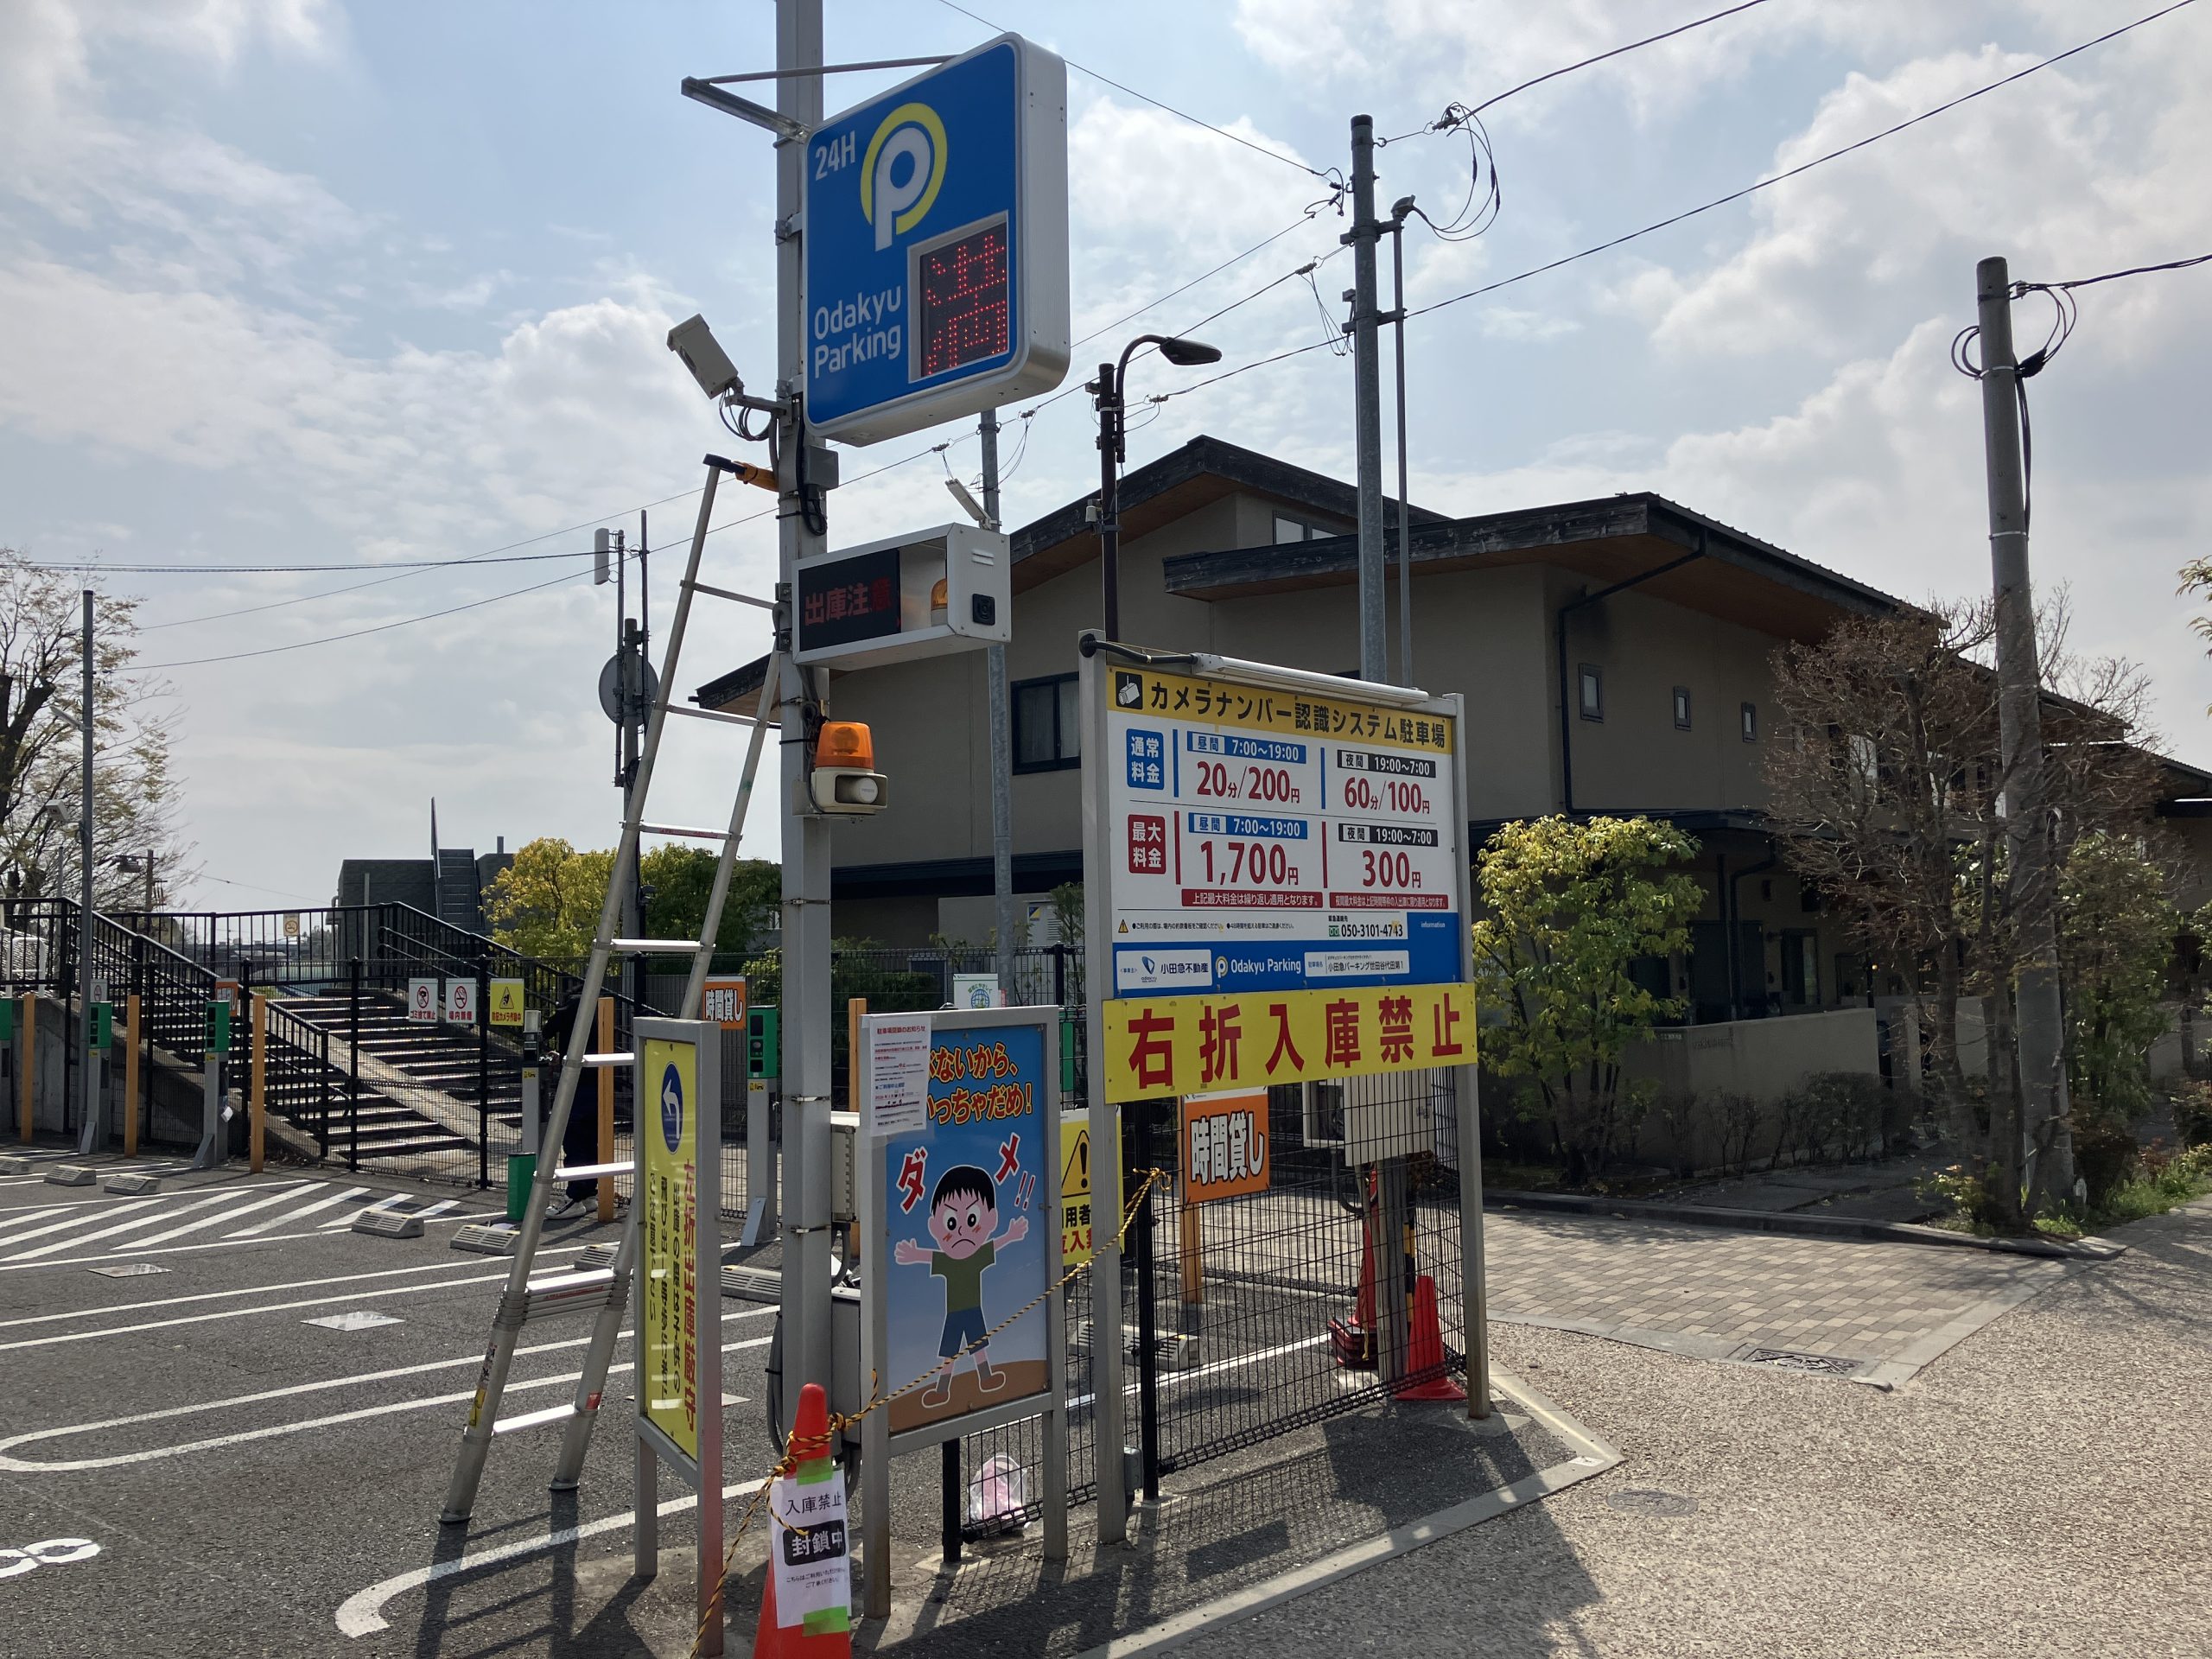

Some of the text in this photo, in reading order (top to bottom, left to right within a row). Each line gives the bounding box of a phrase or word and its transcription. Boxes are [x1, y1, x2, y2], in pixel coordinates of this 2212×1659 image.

[815, 130, 855, 181] 24H
[815, 286, 901, 340] Odakyu
[815, 325, 901, 378] Parking
[804, 576, 891, 626] 出庫注
[1151, 681, 1445, 748] カメラナンバー認識システム駐車場
[1131, 735, 1160, 759] 通常
[1198, 734, 1220, 753] 昼間
[1131, 761, 1160, 784] 料金
[1345, 753, 1364, 769] 夜間
[1197, 760, 1300, 804] 20分/200円
[1344, 777, 1430, 815] 60分/100円
[1133, 822, 1161, 843] 最大
[1198, 817, 1221, 836] 昼間
[1347, 827, 1365, 842] 夜間
[1133, 847, 1162, 868] 料金
[1200, 841, 1299, 886] 1,700円
[1363, 850, 1421, 889] 300円
[1341, 924, 1403, 938] 050-3101-4743
[1160, 963, 1209, 975] 小田急不動産
[1231, 958, 1301, 975] Odakyu Parking
[705, 989, 743, 1021] 時間貸し
[1128, 992, 1463, 1089] 右折入庫禁止
[1190, 1109, 1264, 1185] 時間貸し
[1062, 1204, 1091, 1230] 用者
[785, 1491, 842, 1516] 入庫禁止
[792, 1529, 842, 1558] 封鎖中
